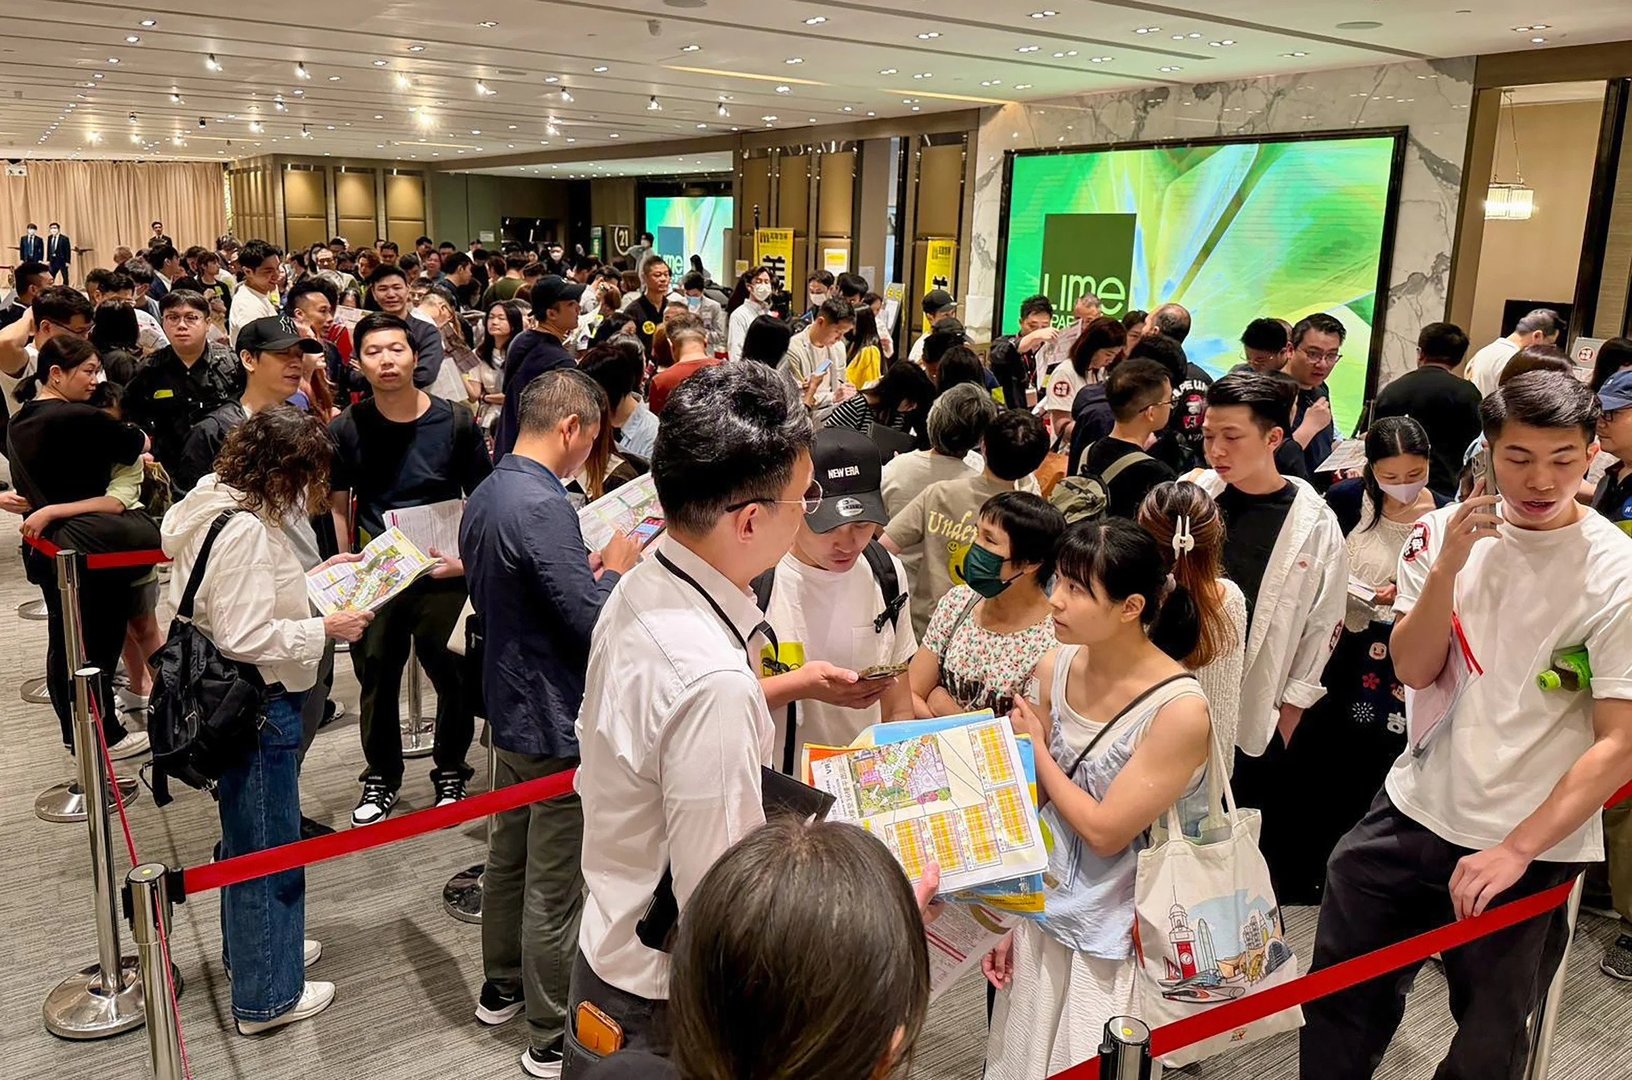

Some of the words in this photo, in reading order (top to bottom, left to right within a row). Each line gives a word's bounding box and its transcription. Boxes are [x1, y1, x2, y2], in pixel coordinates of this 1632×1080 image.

[619, 230, 629, 247] 21
[828, 467, 844, 479] NEW
[844, 465, 860, 477] ERA
